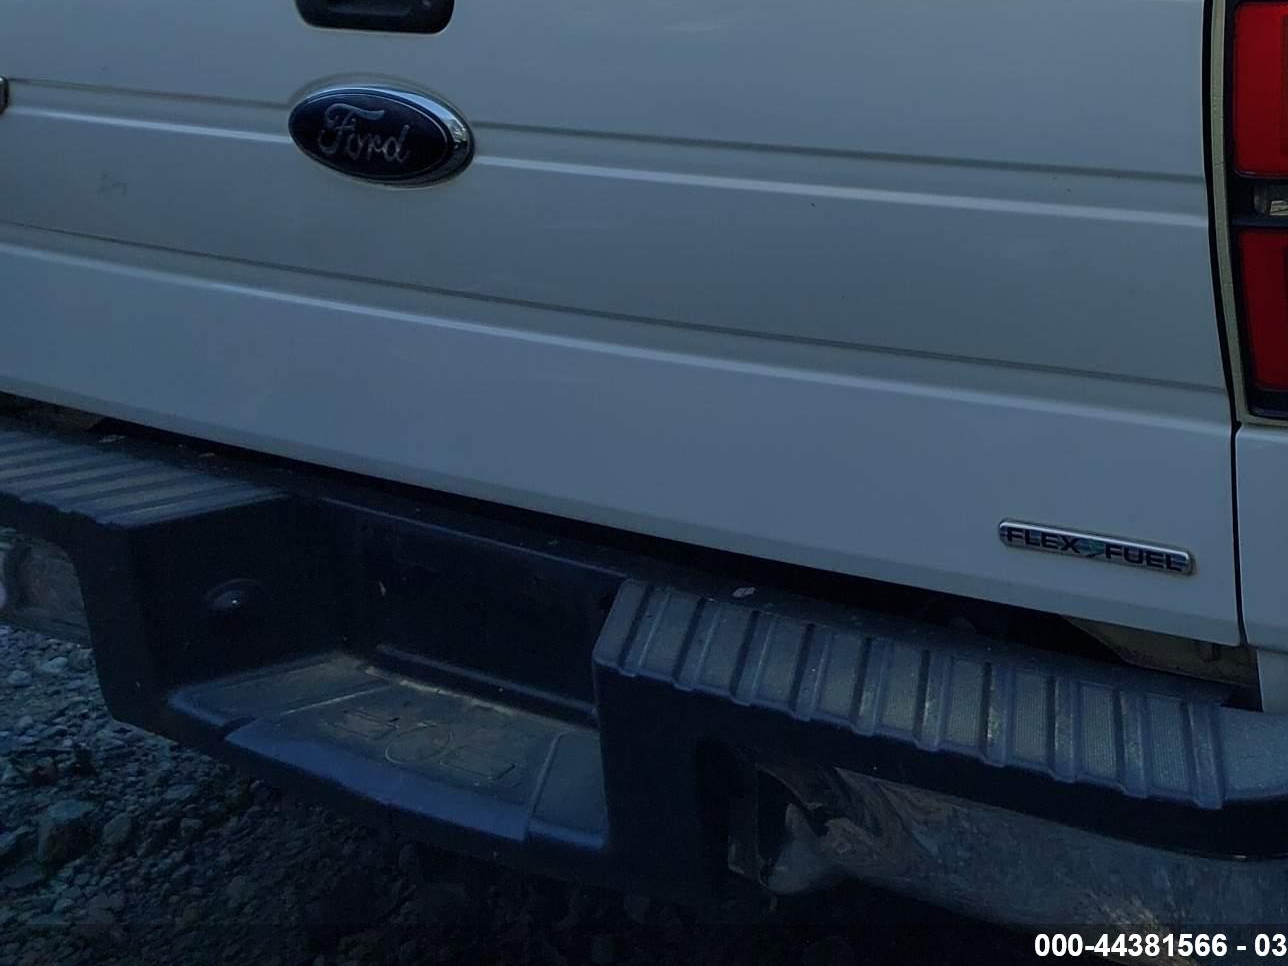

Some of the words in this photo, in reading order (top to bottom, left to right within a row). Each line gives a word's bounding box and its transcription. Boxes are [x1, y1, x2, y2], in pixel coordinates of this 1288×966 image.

[317, 102, 410, 163] Ford
[1006, 526, 1081, 553] FLEX
[1105, 544, 1187, 572] FUEL
